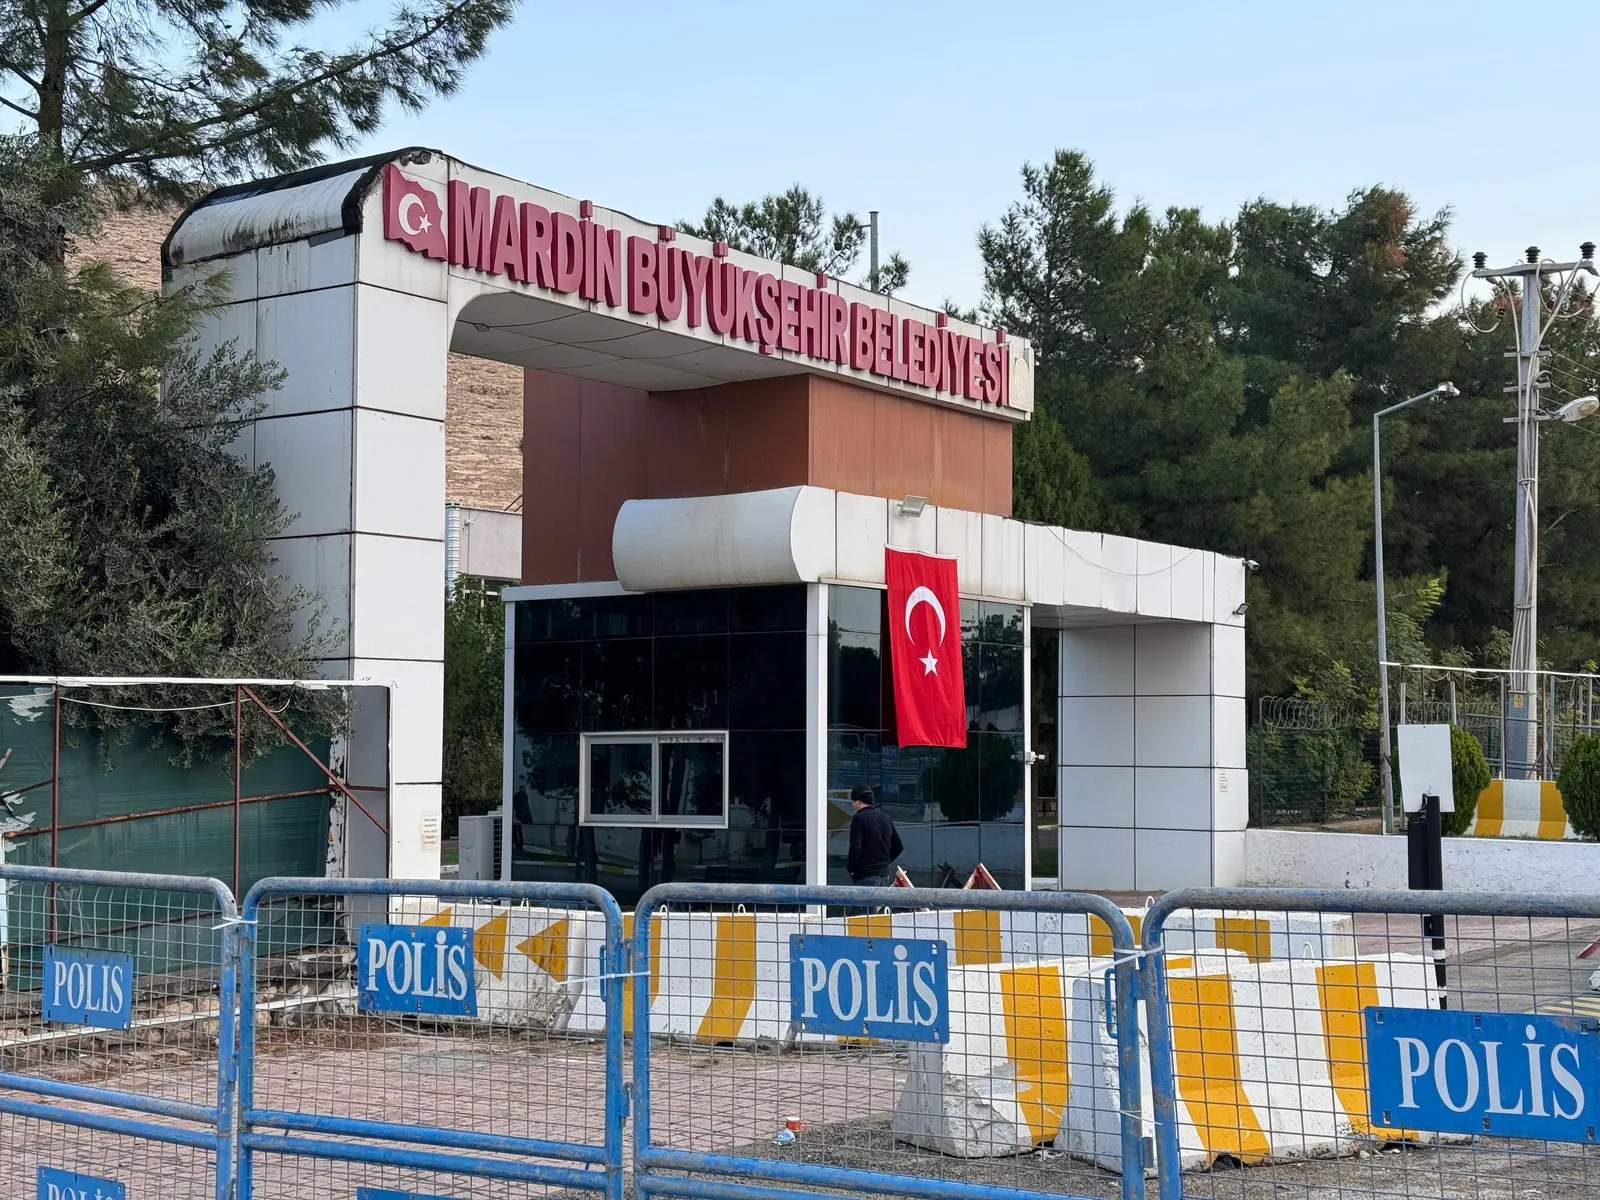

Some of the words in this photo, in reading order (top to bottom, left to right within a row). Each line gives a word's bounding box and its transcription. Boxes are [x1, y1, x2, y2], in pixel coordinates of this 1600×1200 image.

[448, 180, 621, 307] MARDİN
[628, 225, 848, 365] BÜYÜKŞEHİR
[851, 313, 1009, 406] BELEDİYESİ
[366, 930, 468, 1001] POLİS
[800, 944, 938, 1027] POLİS
[1393, 1024, 1585, 1120] POLİS
